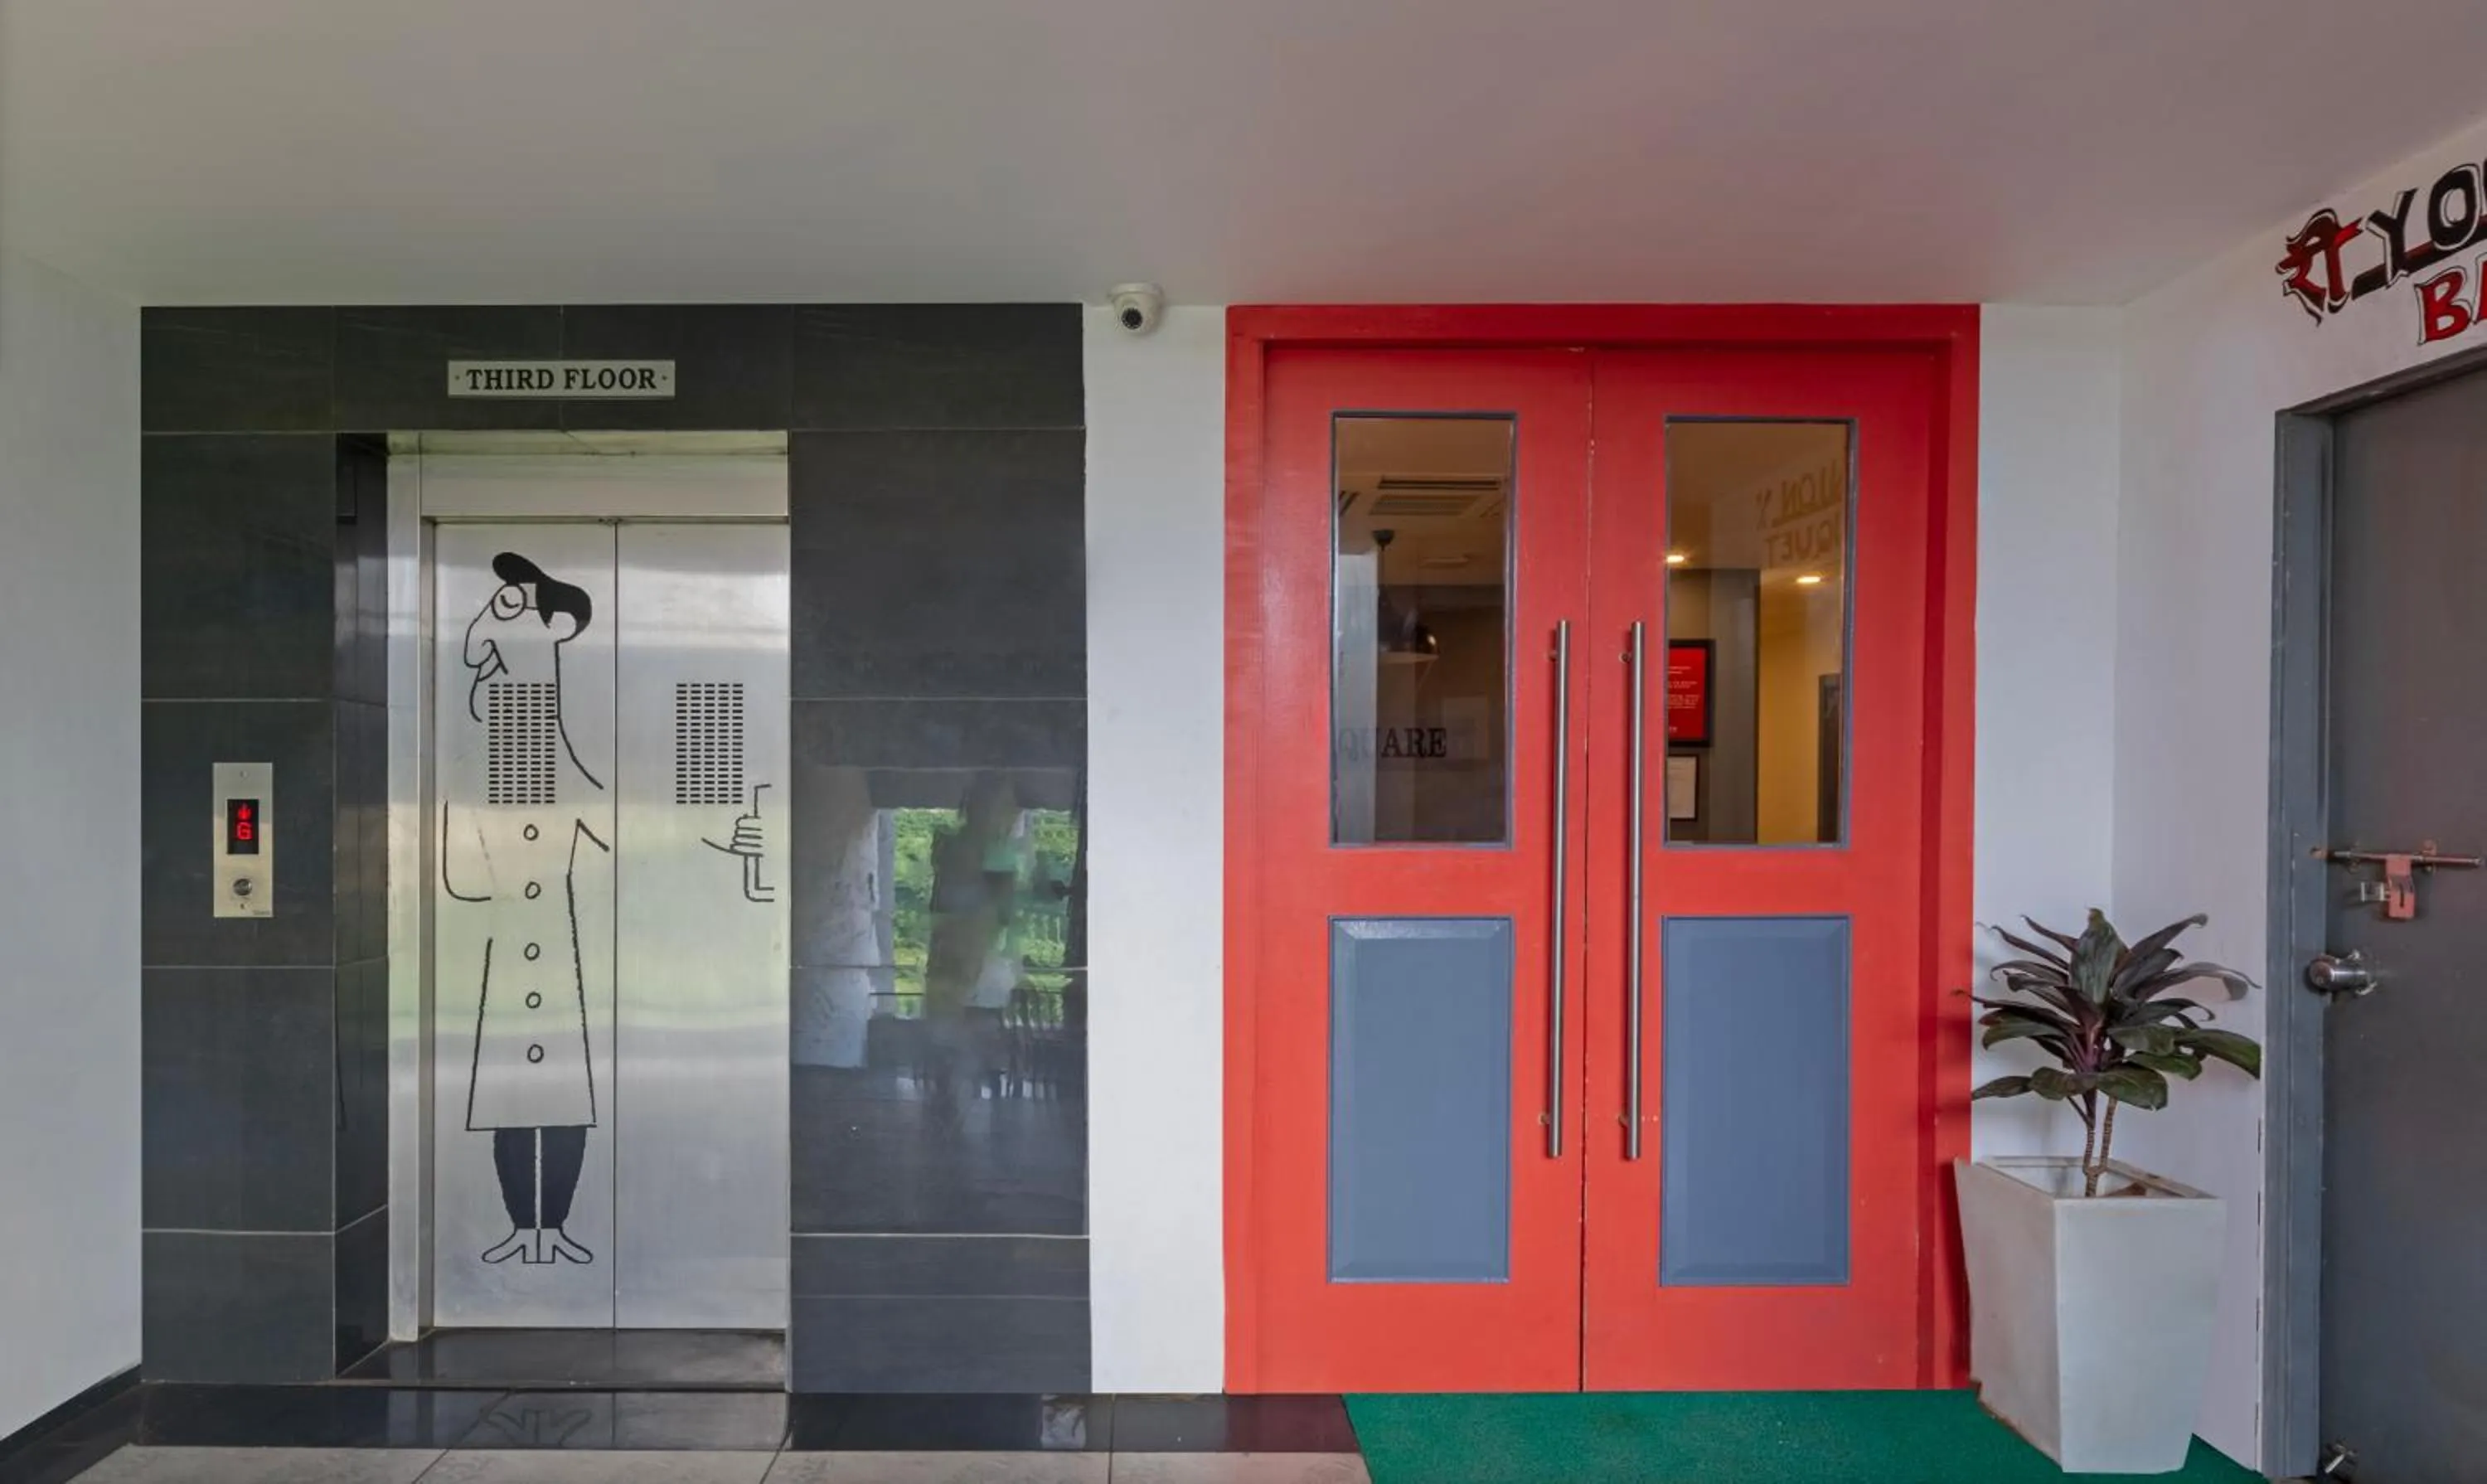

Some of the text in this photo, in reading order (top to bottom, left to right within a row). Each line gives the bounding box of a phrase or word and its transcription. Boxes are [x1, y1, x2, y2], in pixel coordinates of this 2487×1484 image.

[2365, 158, 2487, 289] YO
[2413, 252, 2487, 346] B
[465, 367, 657, 390] THIRD FLOOR
